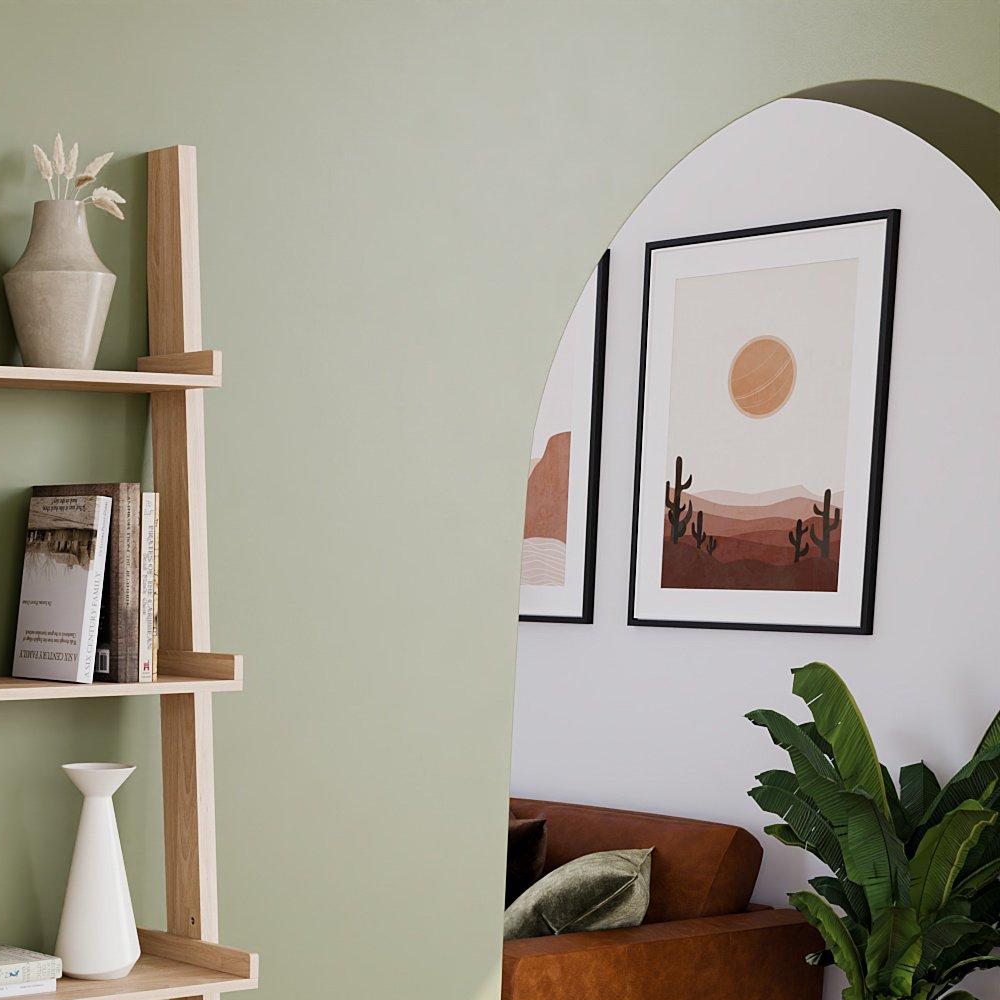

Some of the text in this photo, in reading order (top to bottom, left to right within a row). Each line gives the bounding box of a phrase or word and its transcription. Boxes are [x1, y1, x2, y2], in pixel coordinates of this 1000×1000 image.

[86, 608, 98, 651] CENTURY
[92, 571, 102, 606] FAMILY
[19, 650, 38, 659] FAMILY
[39, 651, 63, 661] CENTURY
[64, 653, 72, 661] SIX
